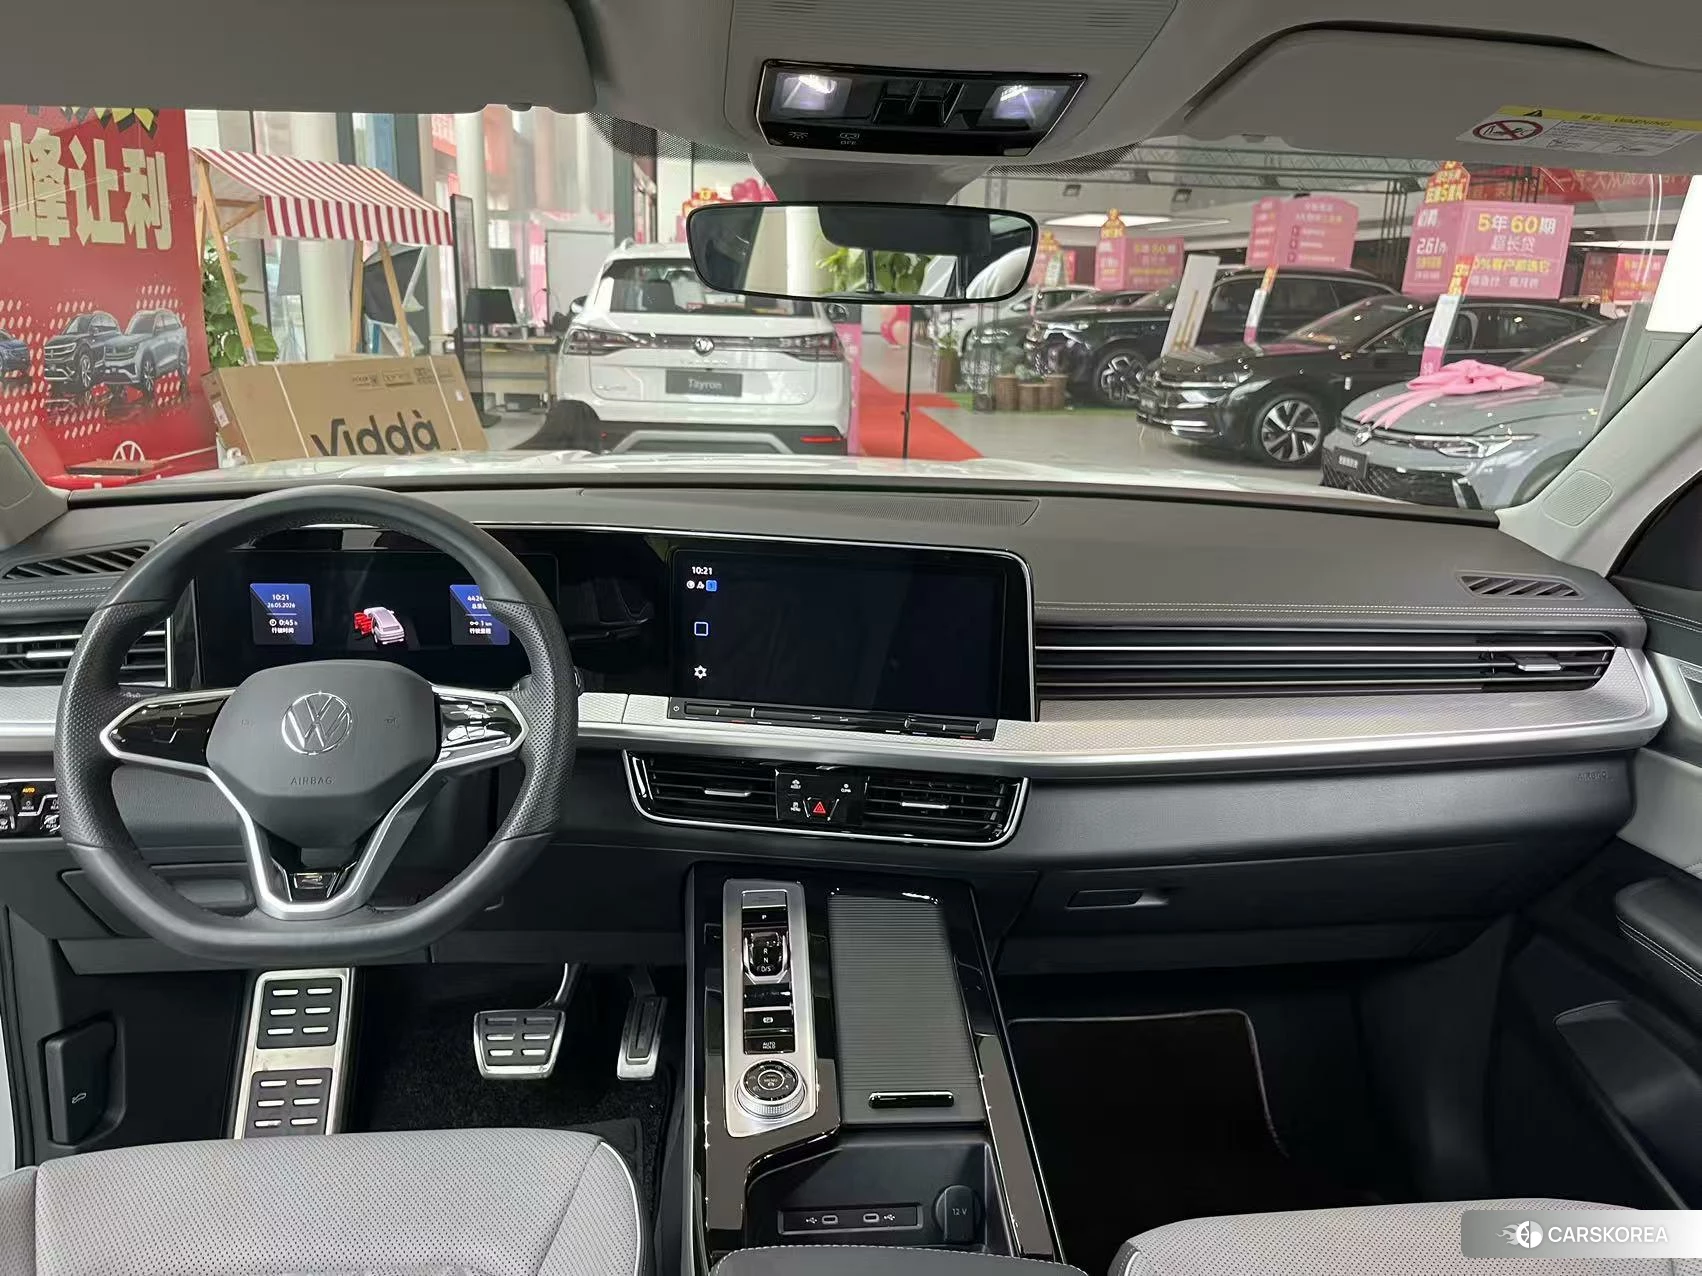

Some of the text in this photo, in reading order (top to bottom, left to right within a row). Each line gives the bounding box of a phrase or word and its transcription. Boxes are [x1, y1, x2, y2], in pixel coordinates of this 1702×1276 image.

[0, 122, 172, 250] 峰让利
[1478, 213, 1556, 235] 5年60期
[687, 378, 722, 390] Tayron
[310, 409, 441, 456] Viddà
[692, 566, 713, 575] 10:21
[290, 776, 334, 785] AIRBAG
